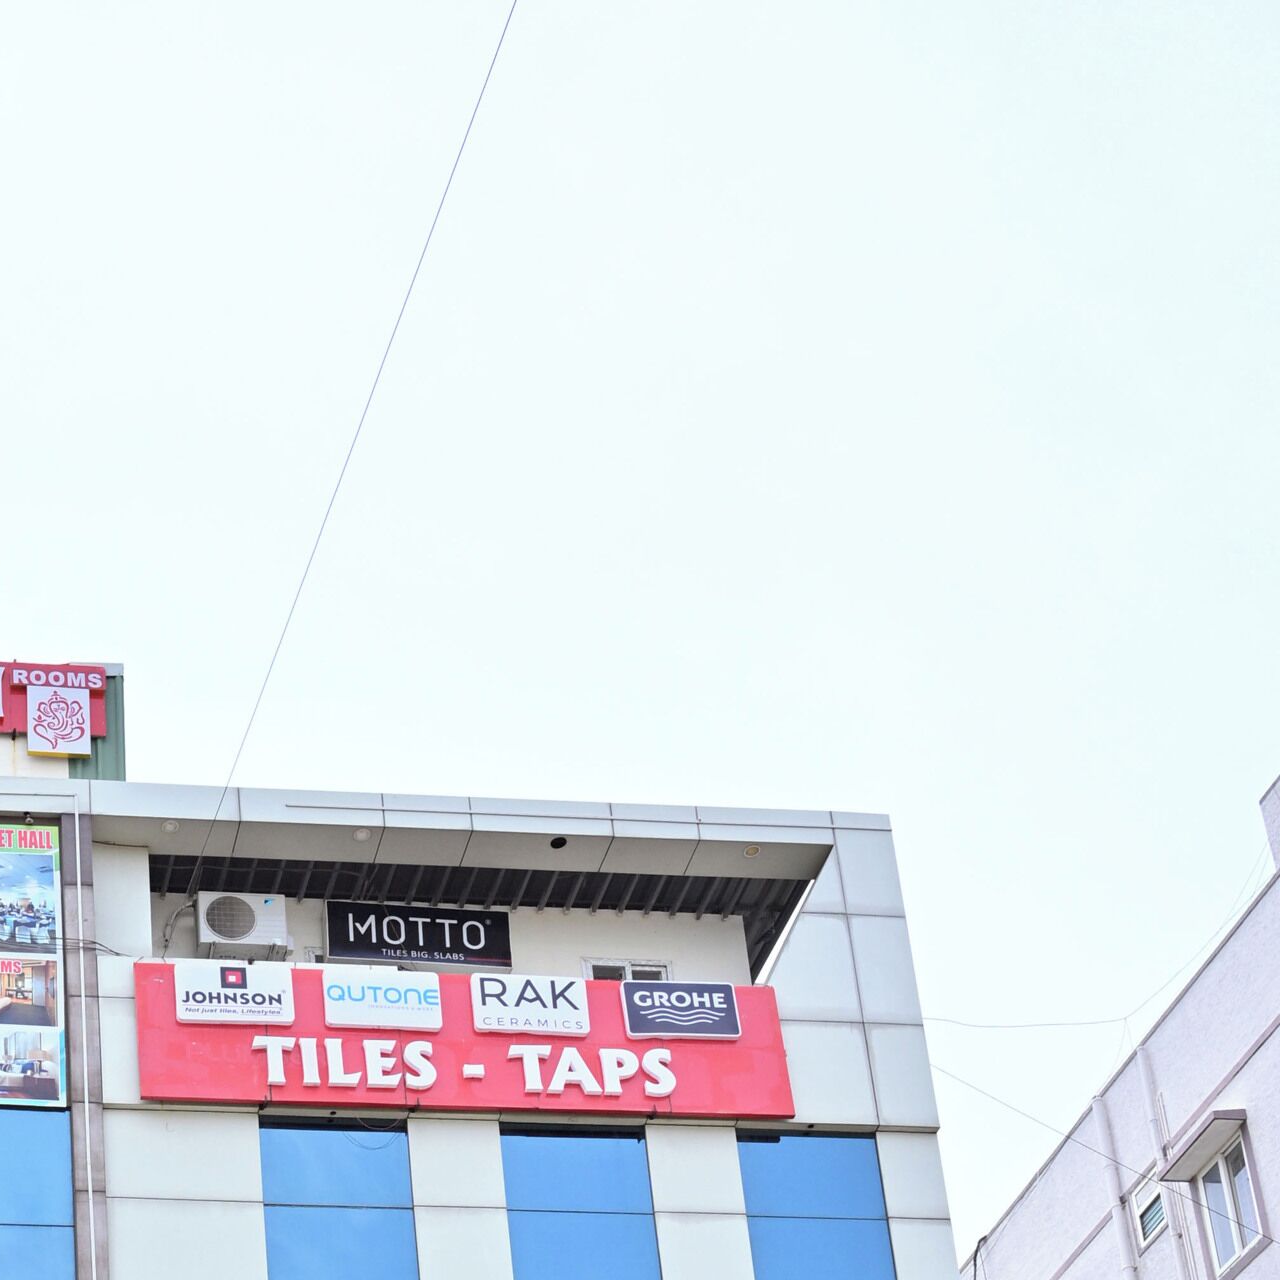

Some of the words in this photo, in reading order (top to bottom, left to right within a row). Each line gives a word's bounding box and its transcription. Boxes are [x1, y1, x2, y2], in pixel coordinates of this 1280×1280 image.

[13, 669, 103, 689] ROOMS
[17, 829, 53, 849] HALL
[348, 913, 486, 950] MOTTO
[381, 948, 408, 958] TILES
[434, 952, 465, 961] SLABS
[182, 990, 282, 1006] JOHNSON
[327, 984, 439, 1005] QUTONE
[478, 977, 580, 1011] RAK
[633, 991, 728, 1009] GROHE
[483, 1016, 584, 1030] CERAMICS
[251, 1036, 437, 1091] TILES
[507, 1044, 677, 1098] TAPS
